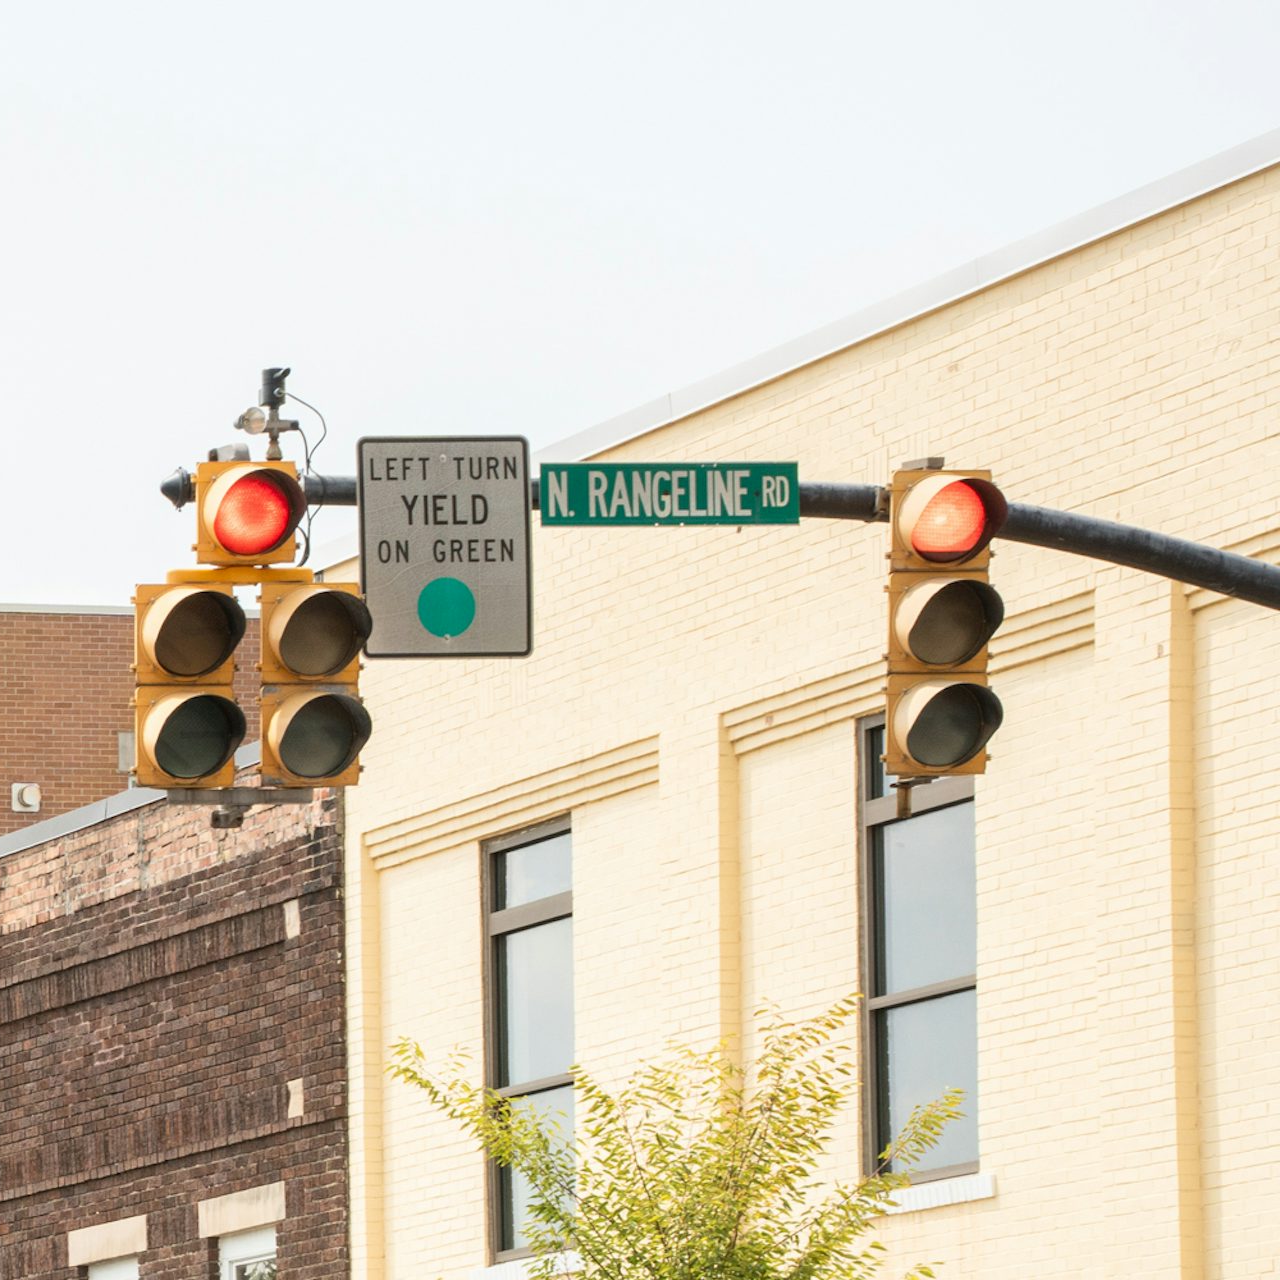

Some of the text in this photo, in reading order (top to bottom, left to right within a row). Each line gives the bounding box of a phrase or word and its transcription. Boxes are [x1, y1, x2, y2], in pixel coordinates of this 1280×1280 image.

[370, 456, 517, 481] LEFT TURN
[548, 470, 790, 518] N. RANGELINE RD
[401, 494, 489, 526] YIELD
[378, 539, 514, 564] ON GREEN
